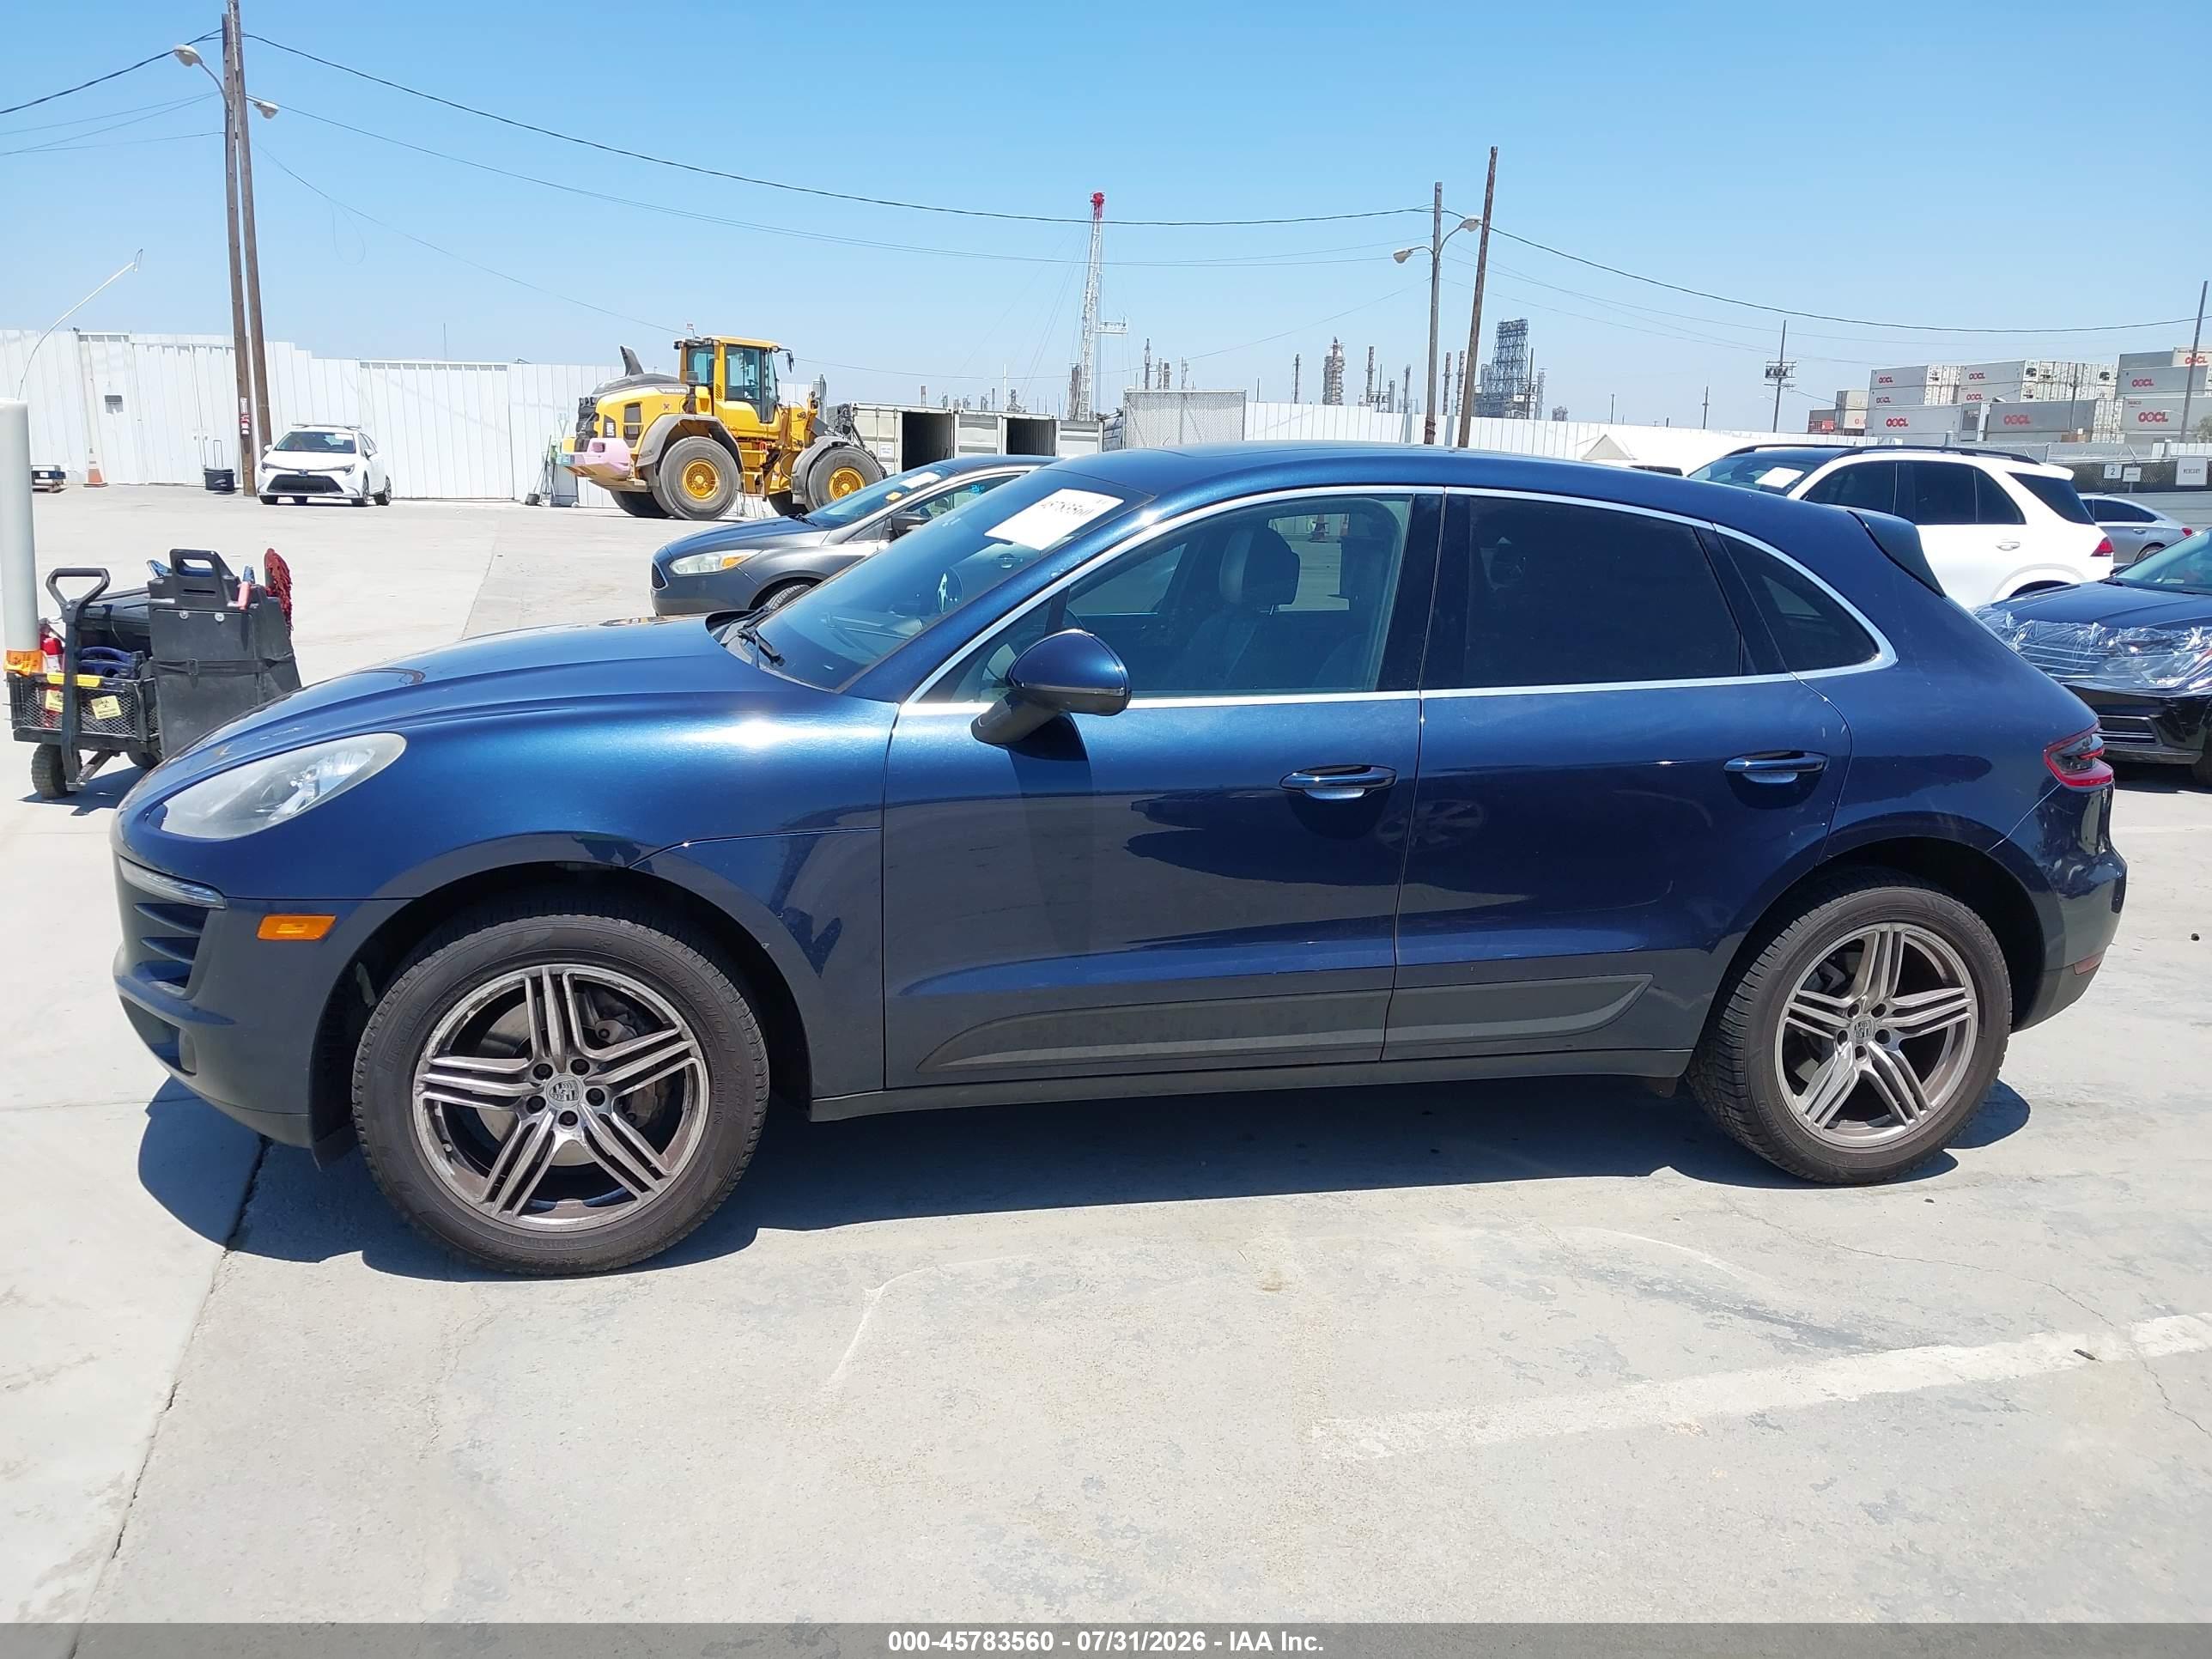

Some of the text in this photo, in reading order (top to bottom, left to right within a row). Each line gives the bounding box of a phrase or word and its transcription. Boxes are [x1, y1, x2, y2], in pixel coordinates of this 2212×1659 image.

[2131, 378, 2154, 387] OOCL
[1886, 416, 1909, 428] OOCL
[2003, 414, 2031, 426] OOCL
[2138, 411, 2169, 422] OOCL
[2110, 467, 2116, 476] 2
